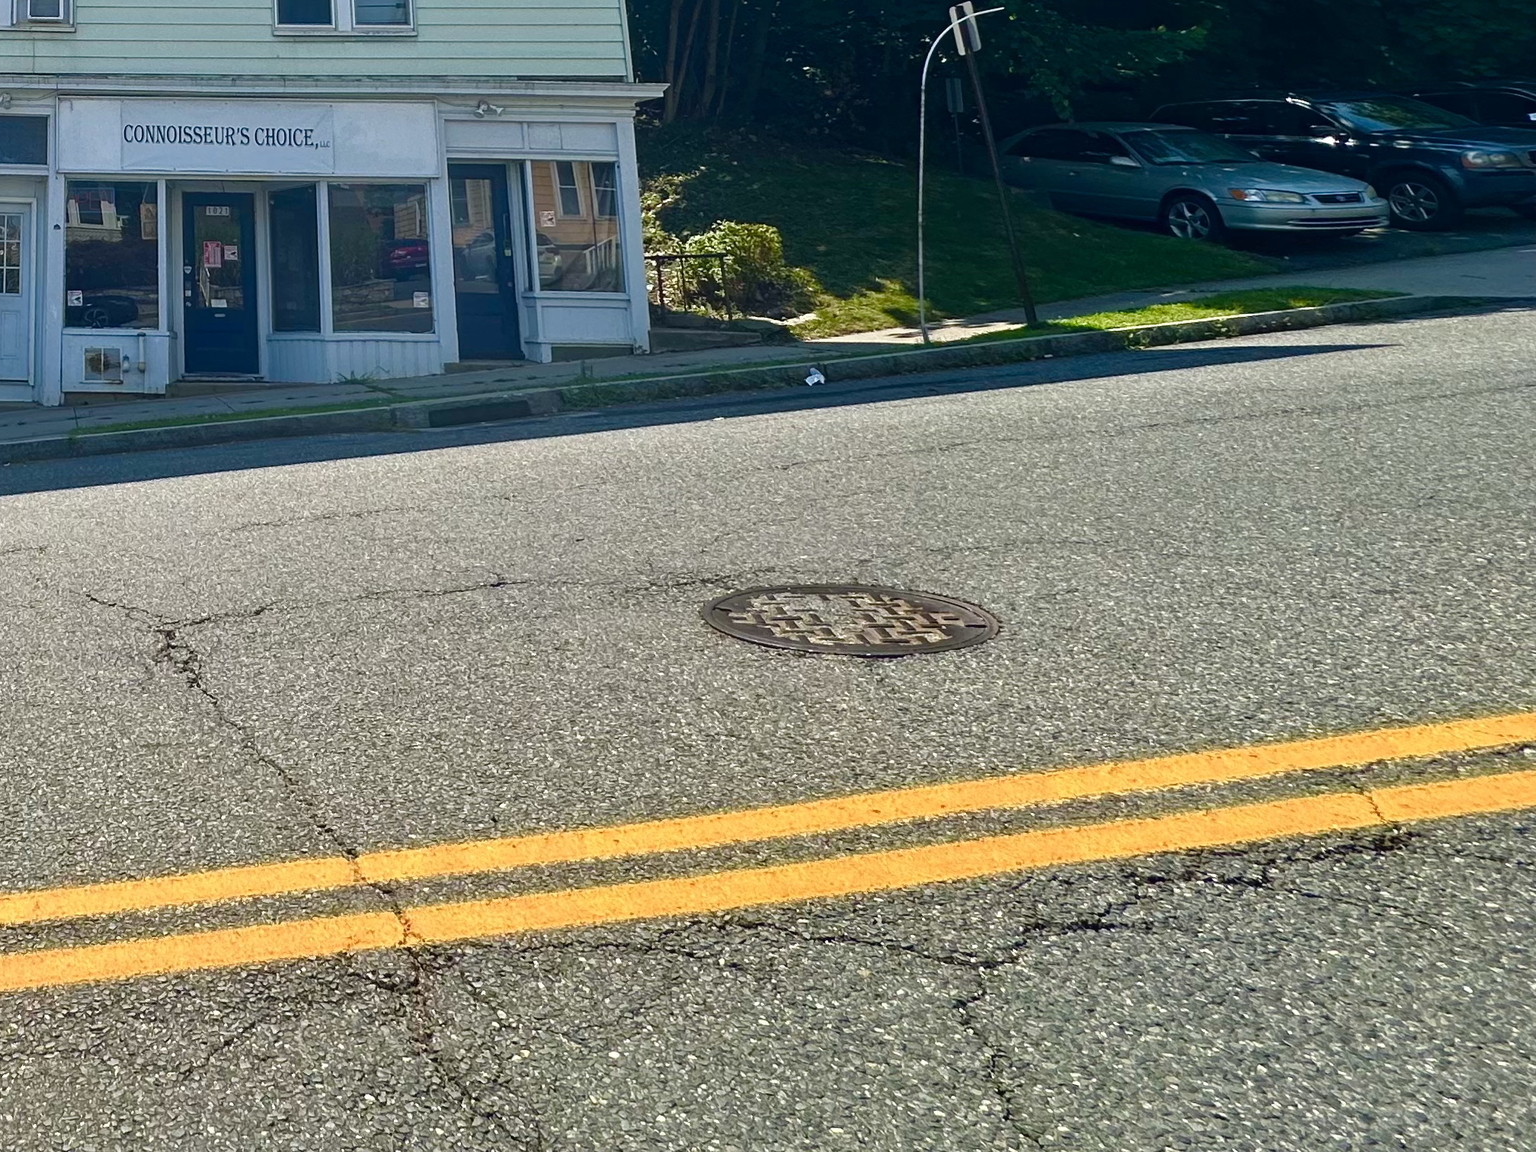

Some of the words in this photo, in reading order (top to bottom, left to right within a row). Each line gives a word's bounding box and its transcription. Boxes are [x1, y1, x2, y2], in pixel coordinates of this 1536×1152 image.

[123, 124, 250, 146] CONNOISSEUR'S
[319, 139, 331, 148] LLC
[207, 206, 229, 215] 1021
